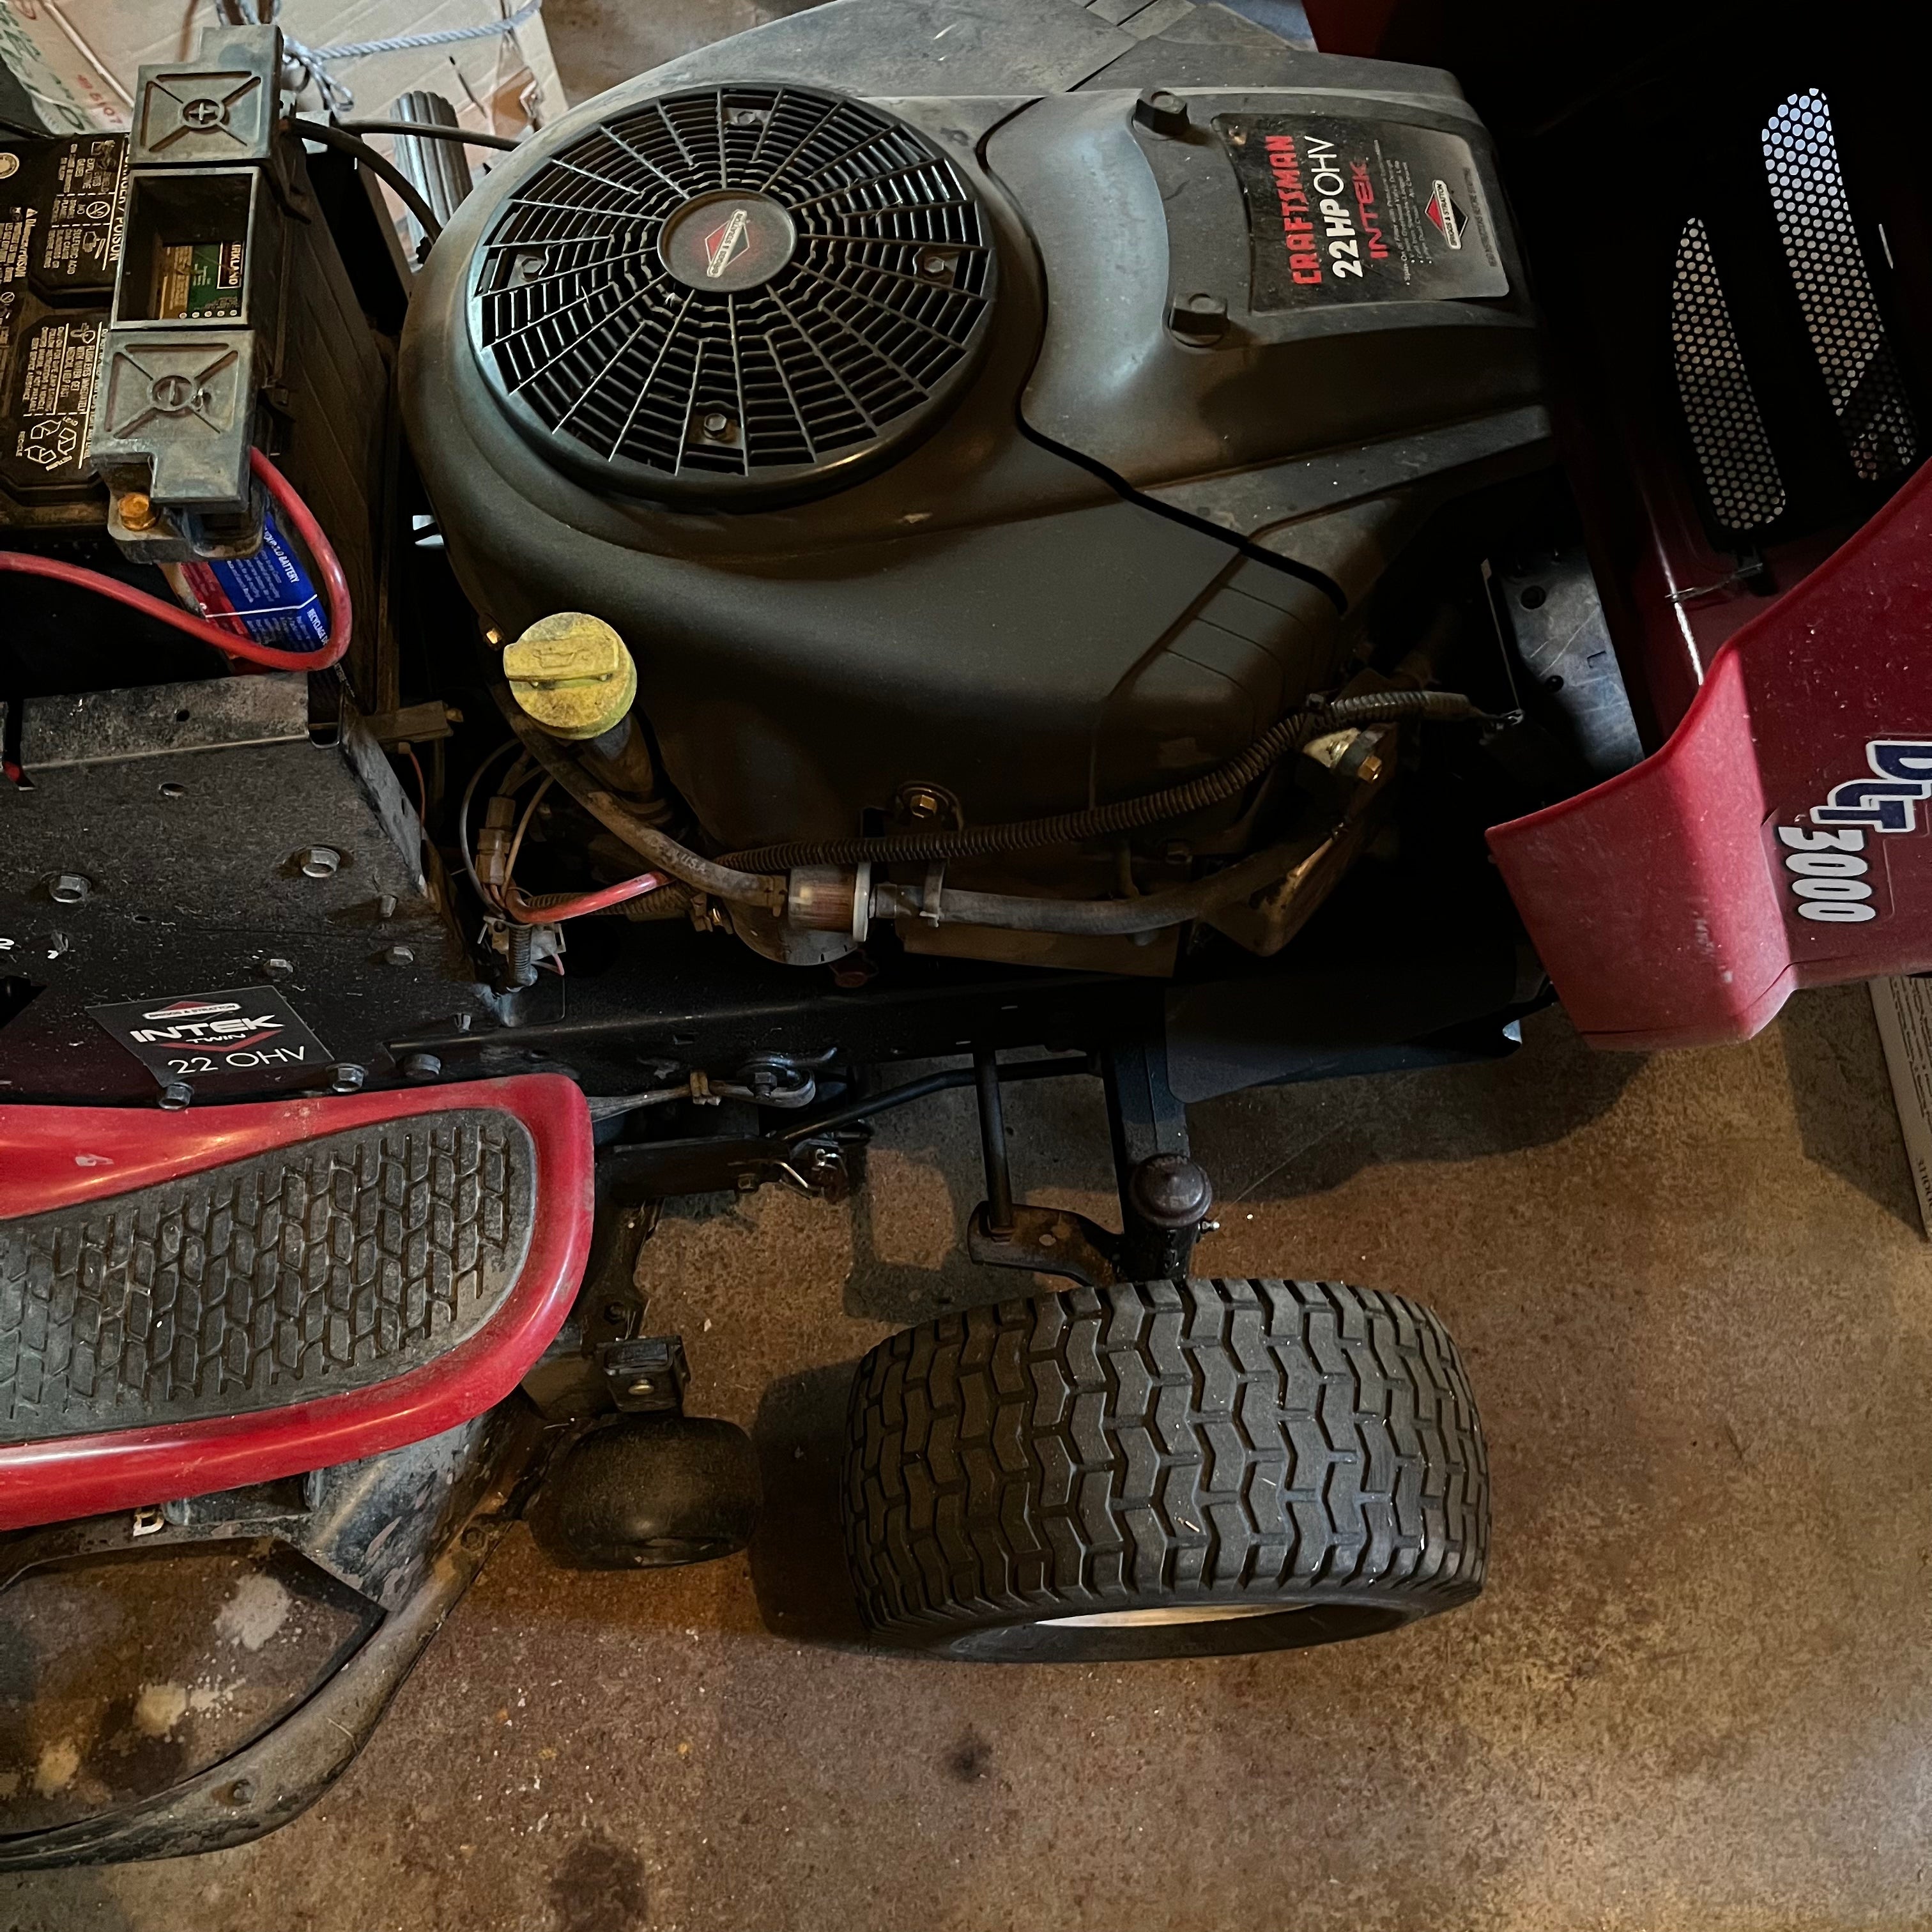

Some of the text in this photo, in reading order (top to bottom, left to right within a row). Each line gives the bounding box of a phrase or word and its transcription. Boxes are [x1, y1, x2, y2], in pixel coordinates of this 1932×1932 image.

[1304, 135, 1344, 197] OHV
[1264, 135, 1322, 284] CRAFTSMAN
[1349, 157, 1389, 259] INTEK
[1436, 183, 1450, 215] STRATTON
[109, 217, 124, 261] POISON
[725, 213, 742, 244] STRATTON
[70, 229, 82, 259] SULFURIC
[82, 363, 93, 377] EYES
[276, 556, 300, 583] BATTERY
[307, 608, 326, 638] RECYCLAGE
[1809, 740, 1932, 832] DLT
[681, 854, 706, 873] USA
[1778, 827, 1876, 922] 3000
[191, 1004, 236, 1013] STRATTON
[130, 1015, 286, 1043] INTEK
[185, 1033, 246, 1044] TWIN
[167, 1045, 305, 1074] 22 OHV
